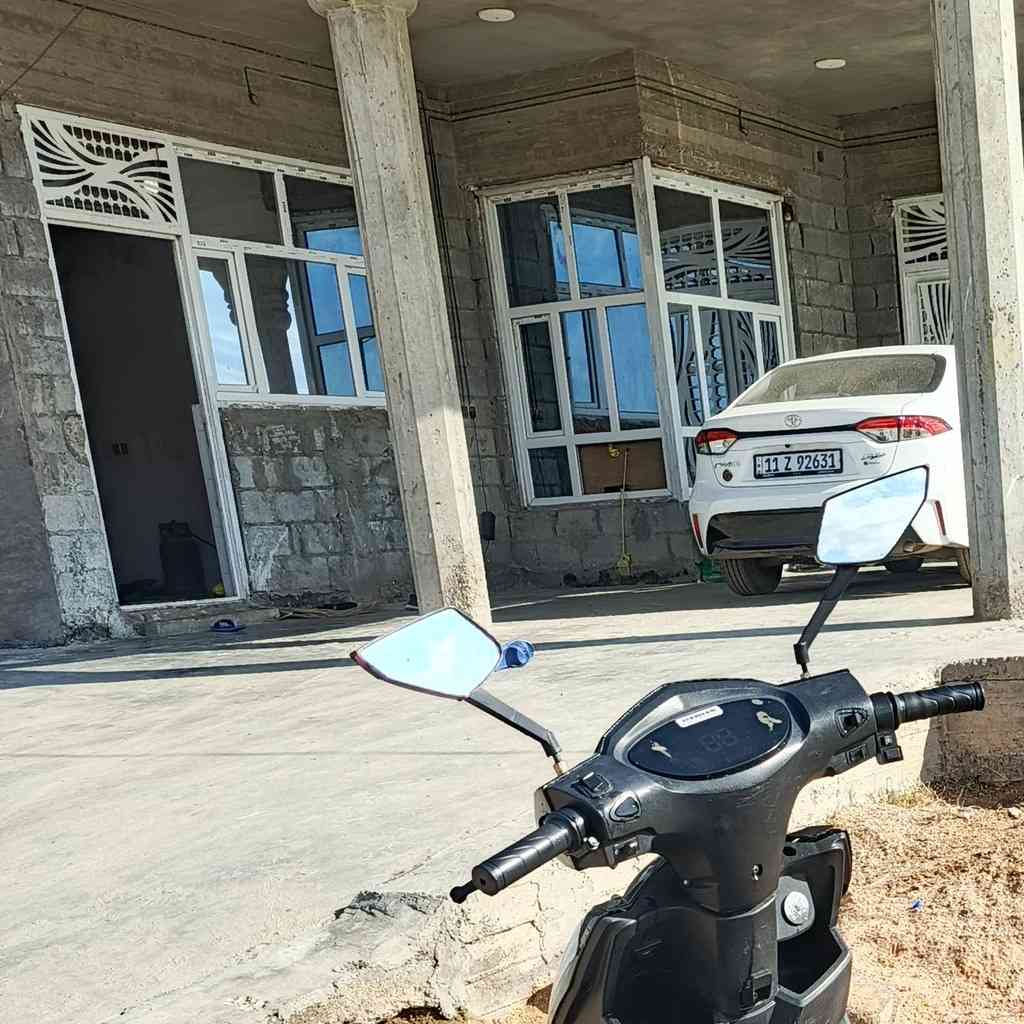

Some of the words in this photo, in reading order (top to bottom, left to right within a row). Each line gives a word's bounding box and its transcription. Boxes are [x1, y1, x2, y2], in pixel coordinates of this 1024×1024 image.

[765, 457, 780, 473] 11
[785, 455, 793, 471] Z
[797, 453, 836, 470] 92631
